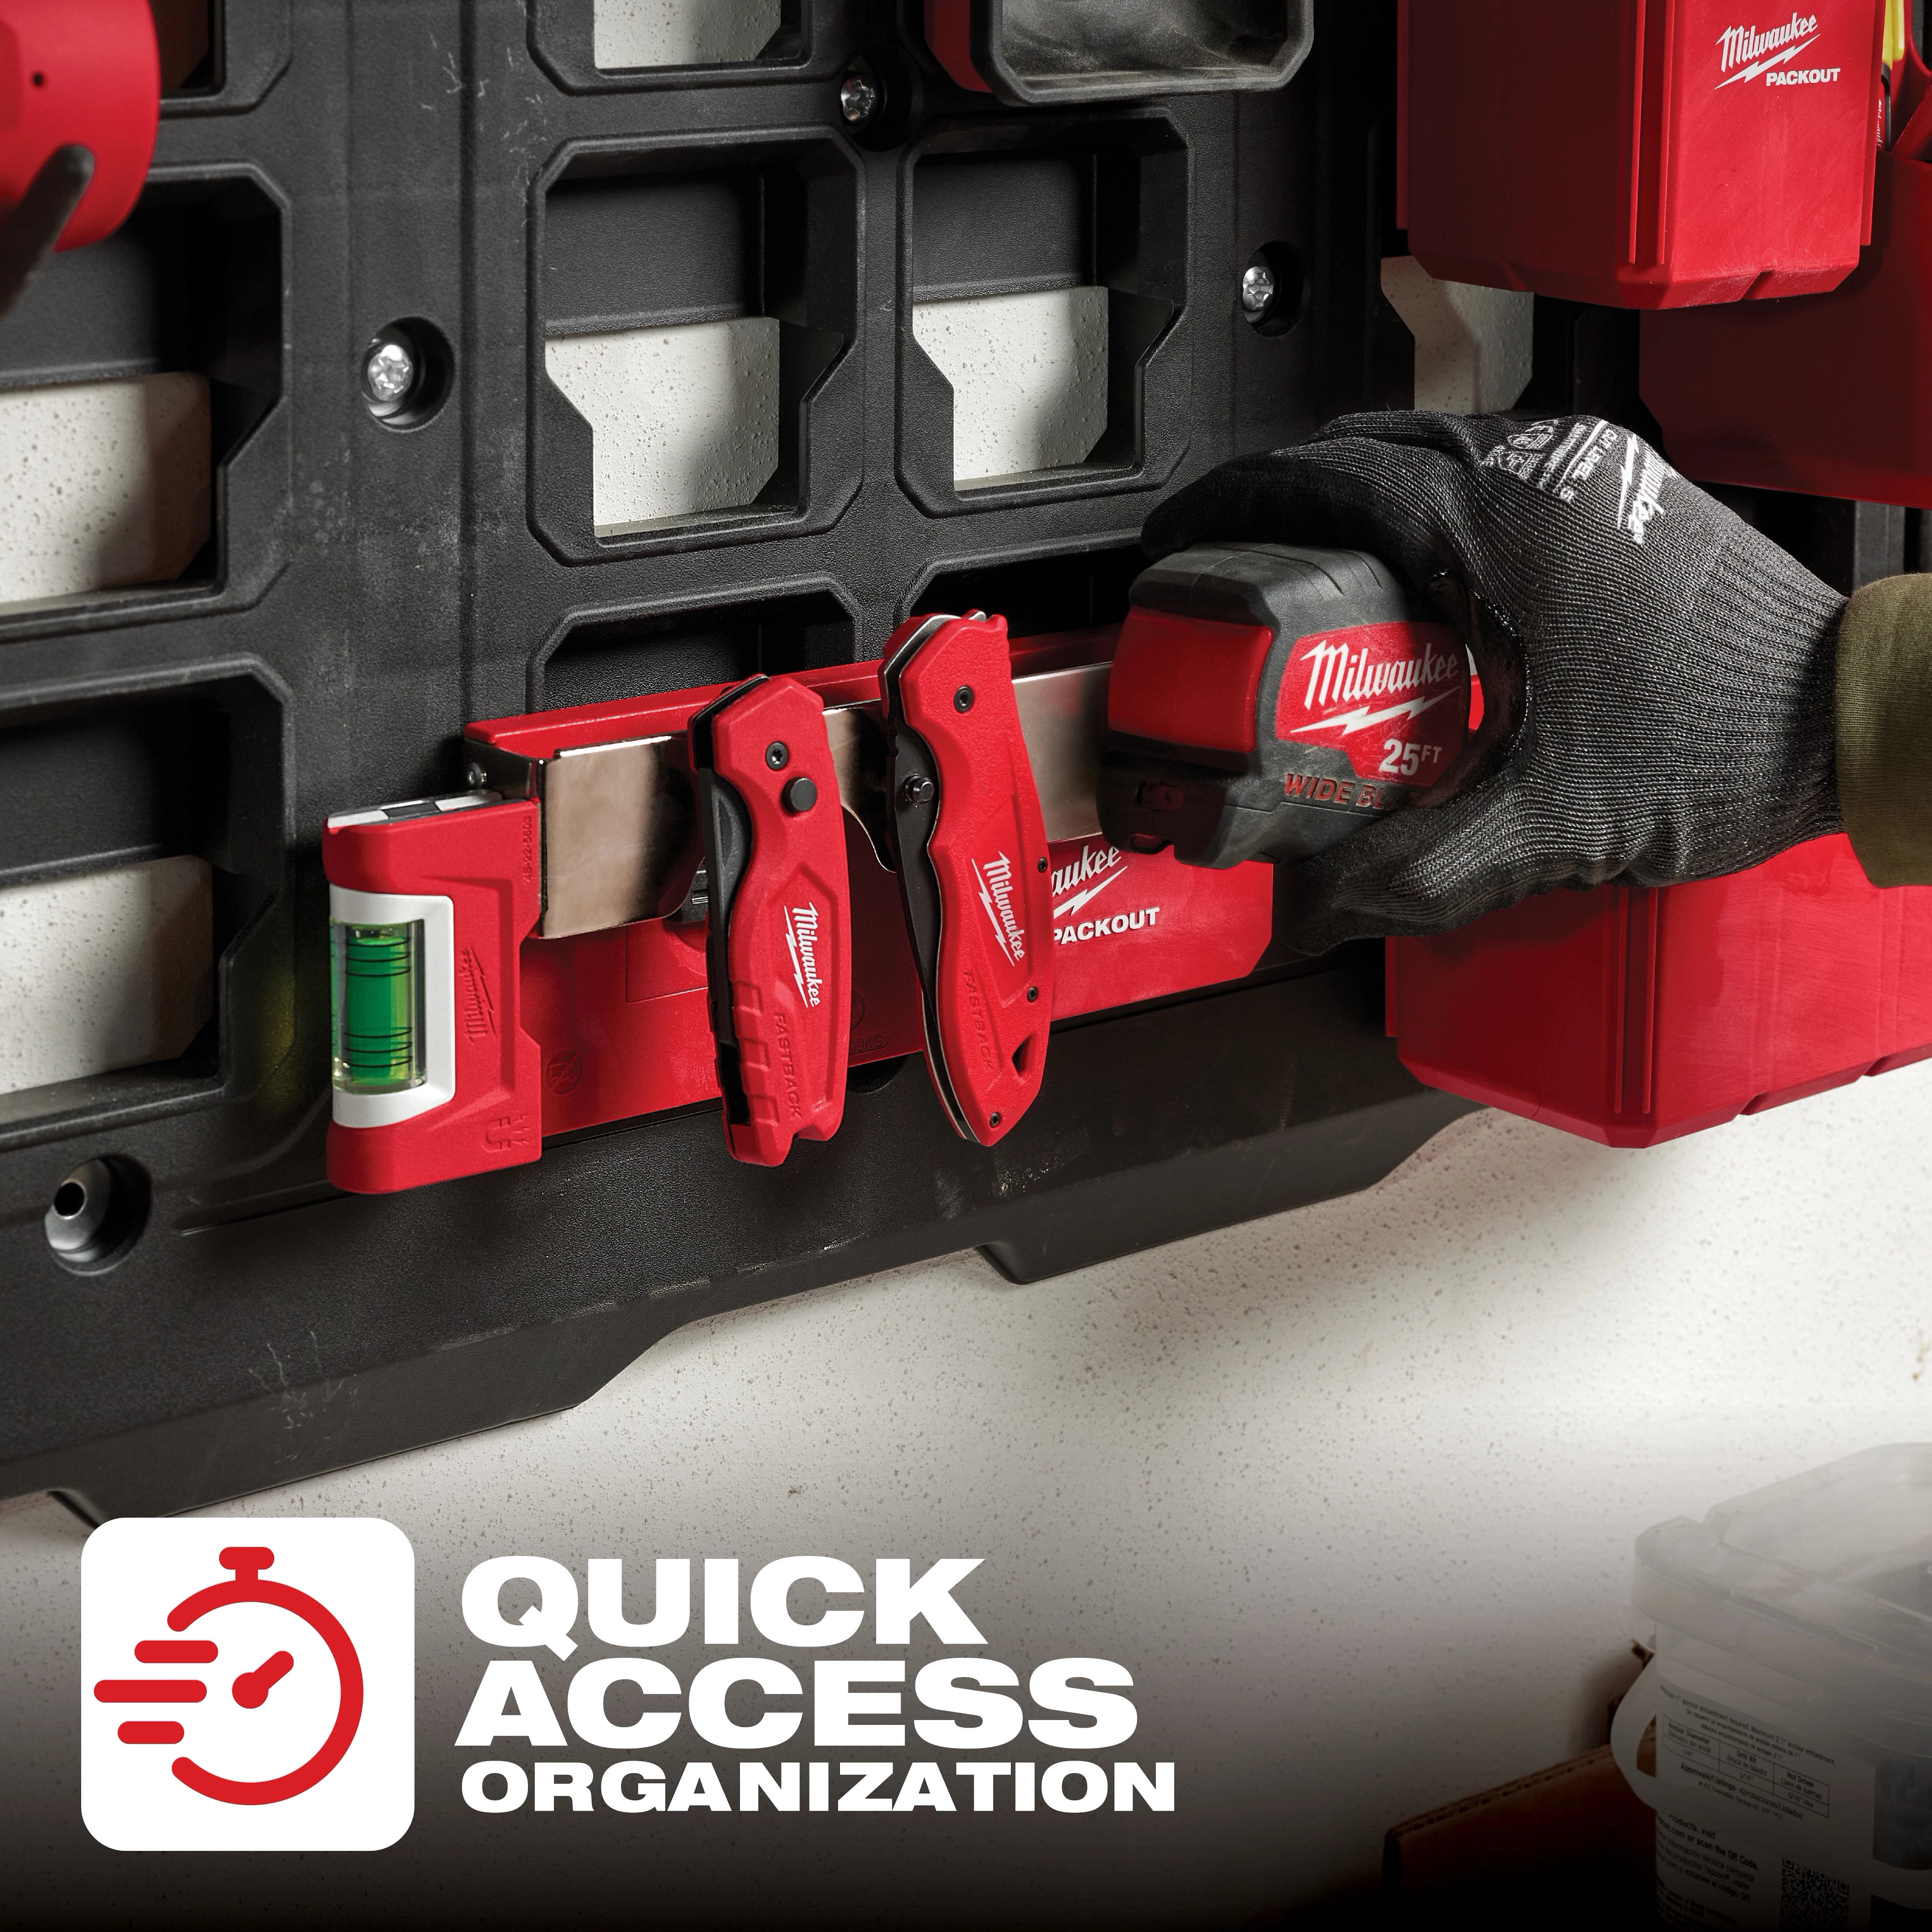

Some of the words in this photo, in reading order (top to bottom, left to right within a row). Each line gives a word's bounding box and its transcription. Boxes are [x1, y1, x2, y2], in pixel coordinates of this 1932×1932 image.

[1715, 12, 1818, 73] Milwaukee
[1765, 68, 1841, 87] PACKOUT
[1603, 428, 1618, 450] CUT
[1572, 445, 1605, 481] LEVEL
[1300, 639, 1459, 710] Milwaukee
[1284, 773, 1355, 805] WIDE
[1051, 845, 1121, 898] aukee
[982, 850, 1025, 962] Milwaukee
[791, 901, 821, 1008] Milwaukee
[963, 968, 995, 1072] FASTBACK
[774, 1011, 802, 1122] FASTBACK
[1736, 1750, 1748, 1761] Drill
[1750, 1764, 1767, 1776] taladro
[1787, 1771, 1796, 1781] Nut
[1798, 1776, 1815, 1788] Driver
[1803, 1787, 1822, 1800] tuercas
[1804, 1798, 1814, 1808] Hex
[1687, 1834, 1694, 1843] or
[1697, 1838, 1713, 1851] scan
[1715, 1845, 1726, 1857] the
[1728, 1850, 1738, 1861] QR
[1701, 1828, 1716, 1840] visit
